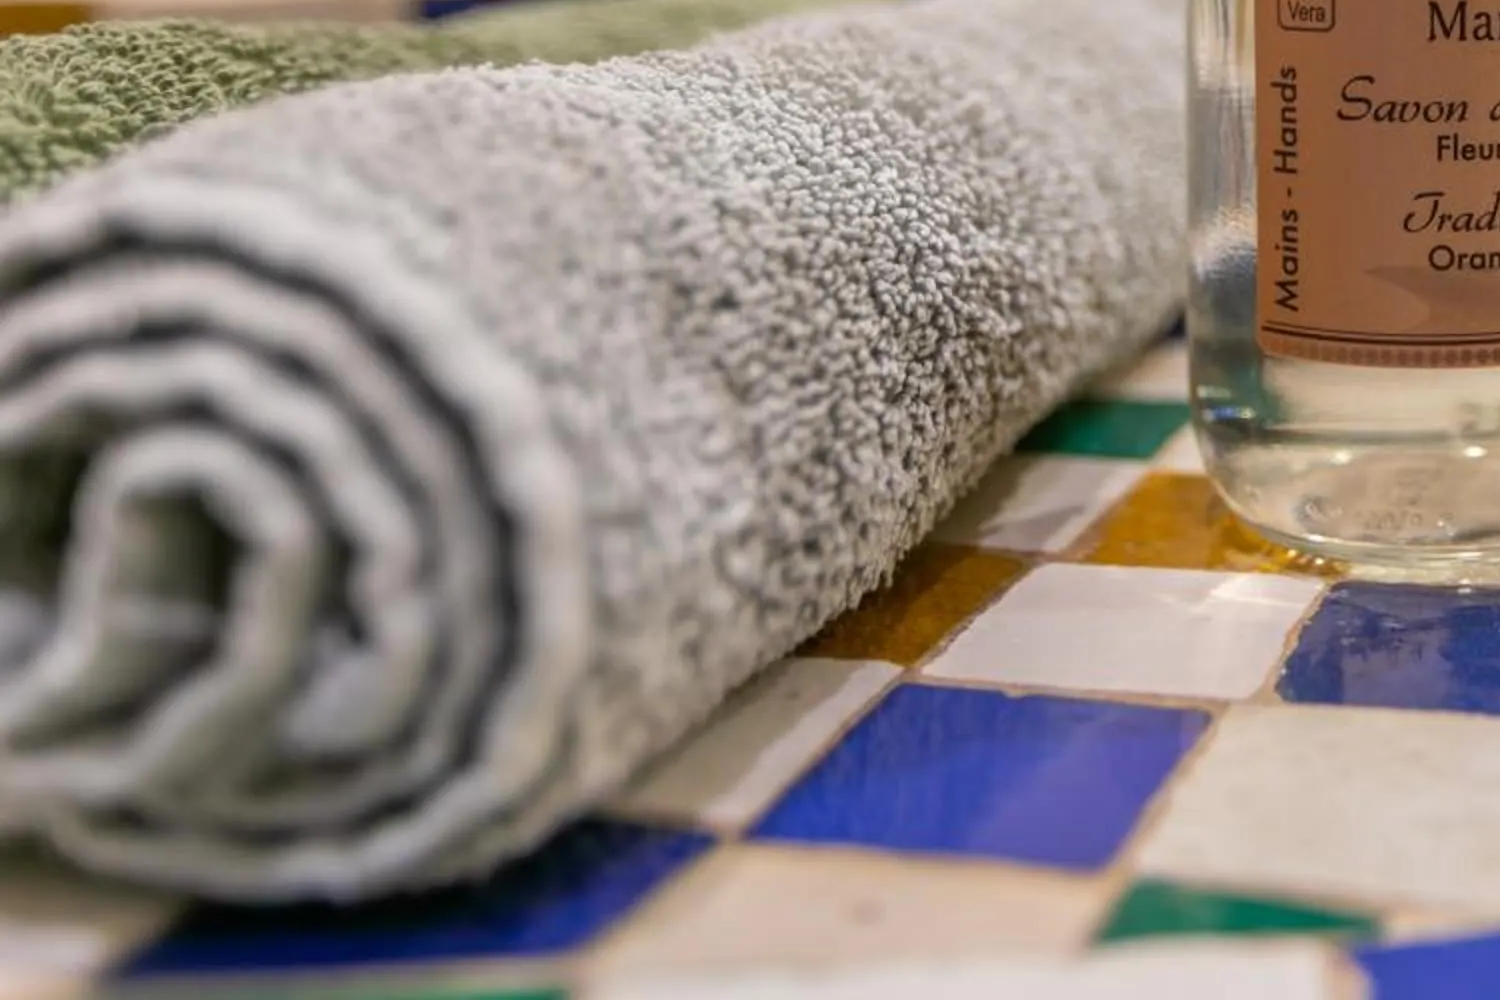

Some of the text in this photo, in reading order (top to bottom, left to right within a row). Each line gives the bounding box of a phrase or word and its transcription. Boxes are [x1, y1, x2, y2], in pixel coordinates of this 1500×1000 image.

[1287, 0, 1326, 22] Vera
[1270, 65, 1298, 175] Hands
[1336, 74, 1470, 124] Savon
[1274, 209, 1300, 313] Mains
